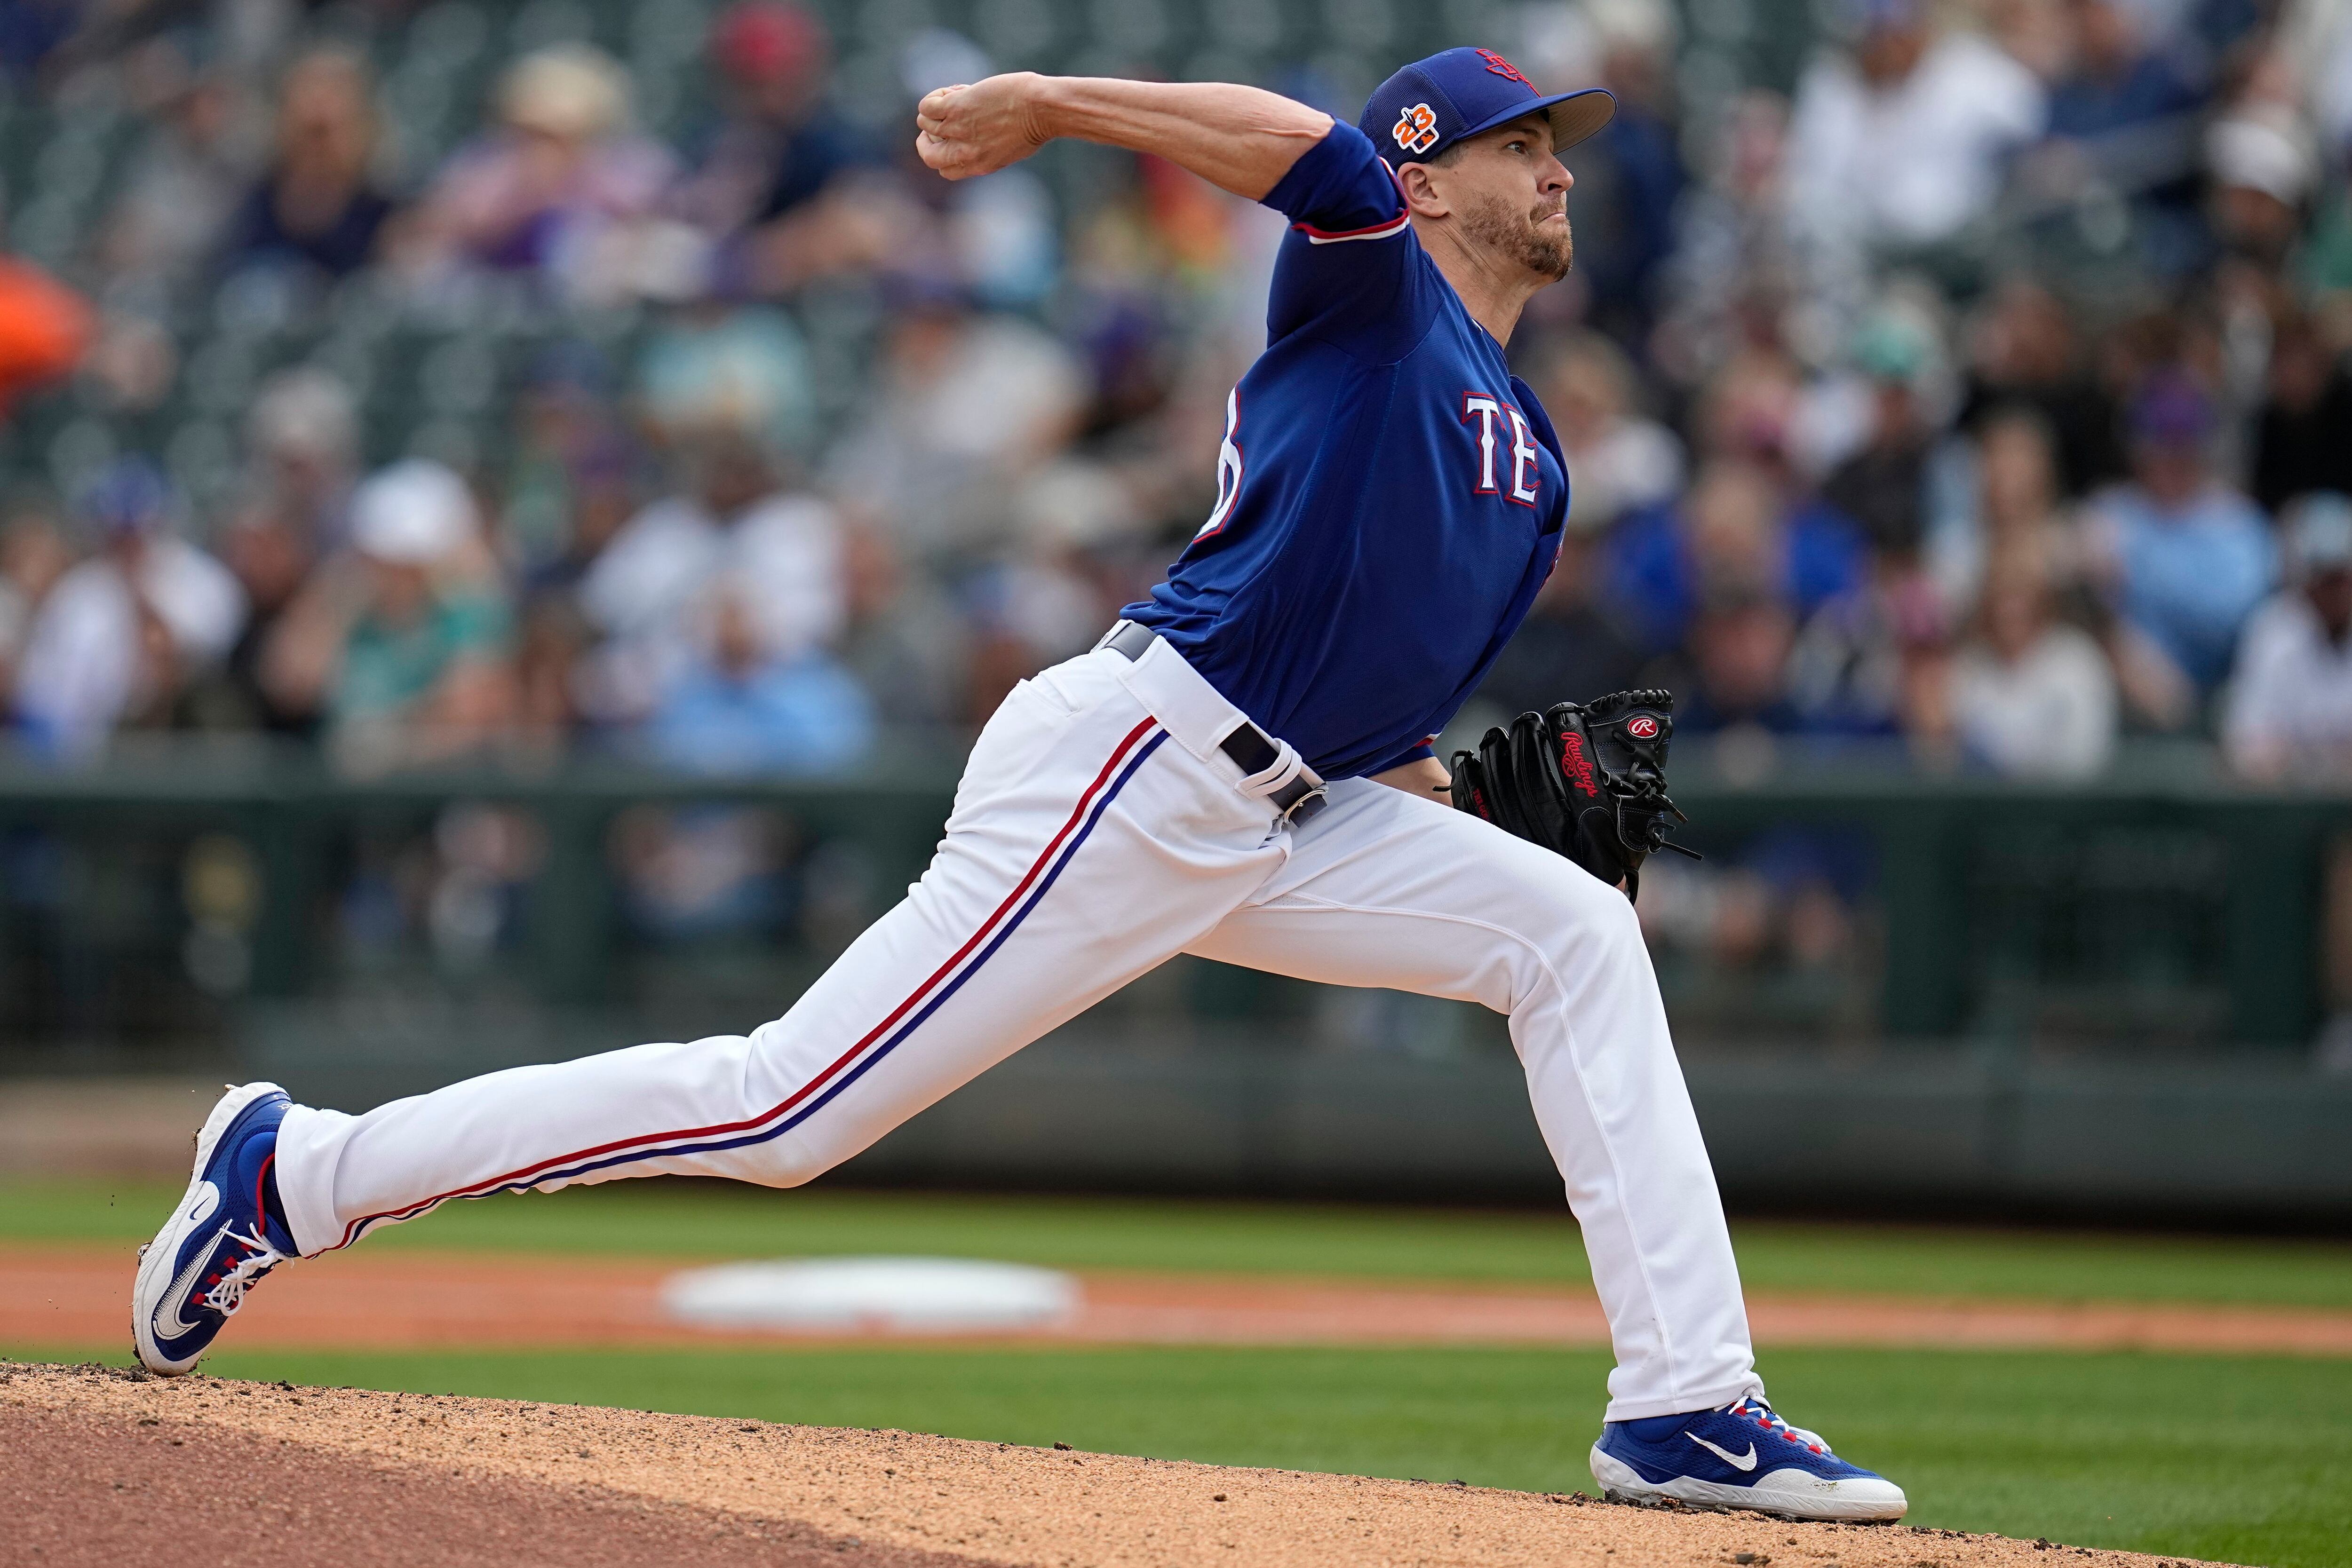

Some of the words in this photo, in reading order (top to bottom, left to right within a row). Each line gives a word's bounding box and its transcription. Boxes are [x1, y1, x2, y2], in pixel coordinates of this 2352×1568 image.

[1396, 106, 1433, 145] 23
[1631, 719, 1655, 734] R
[1561, 732, 1598, 798] Rawlings
